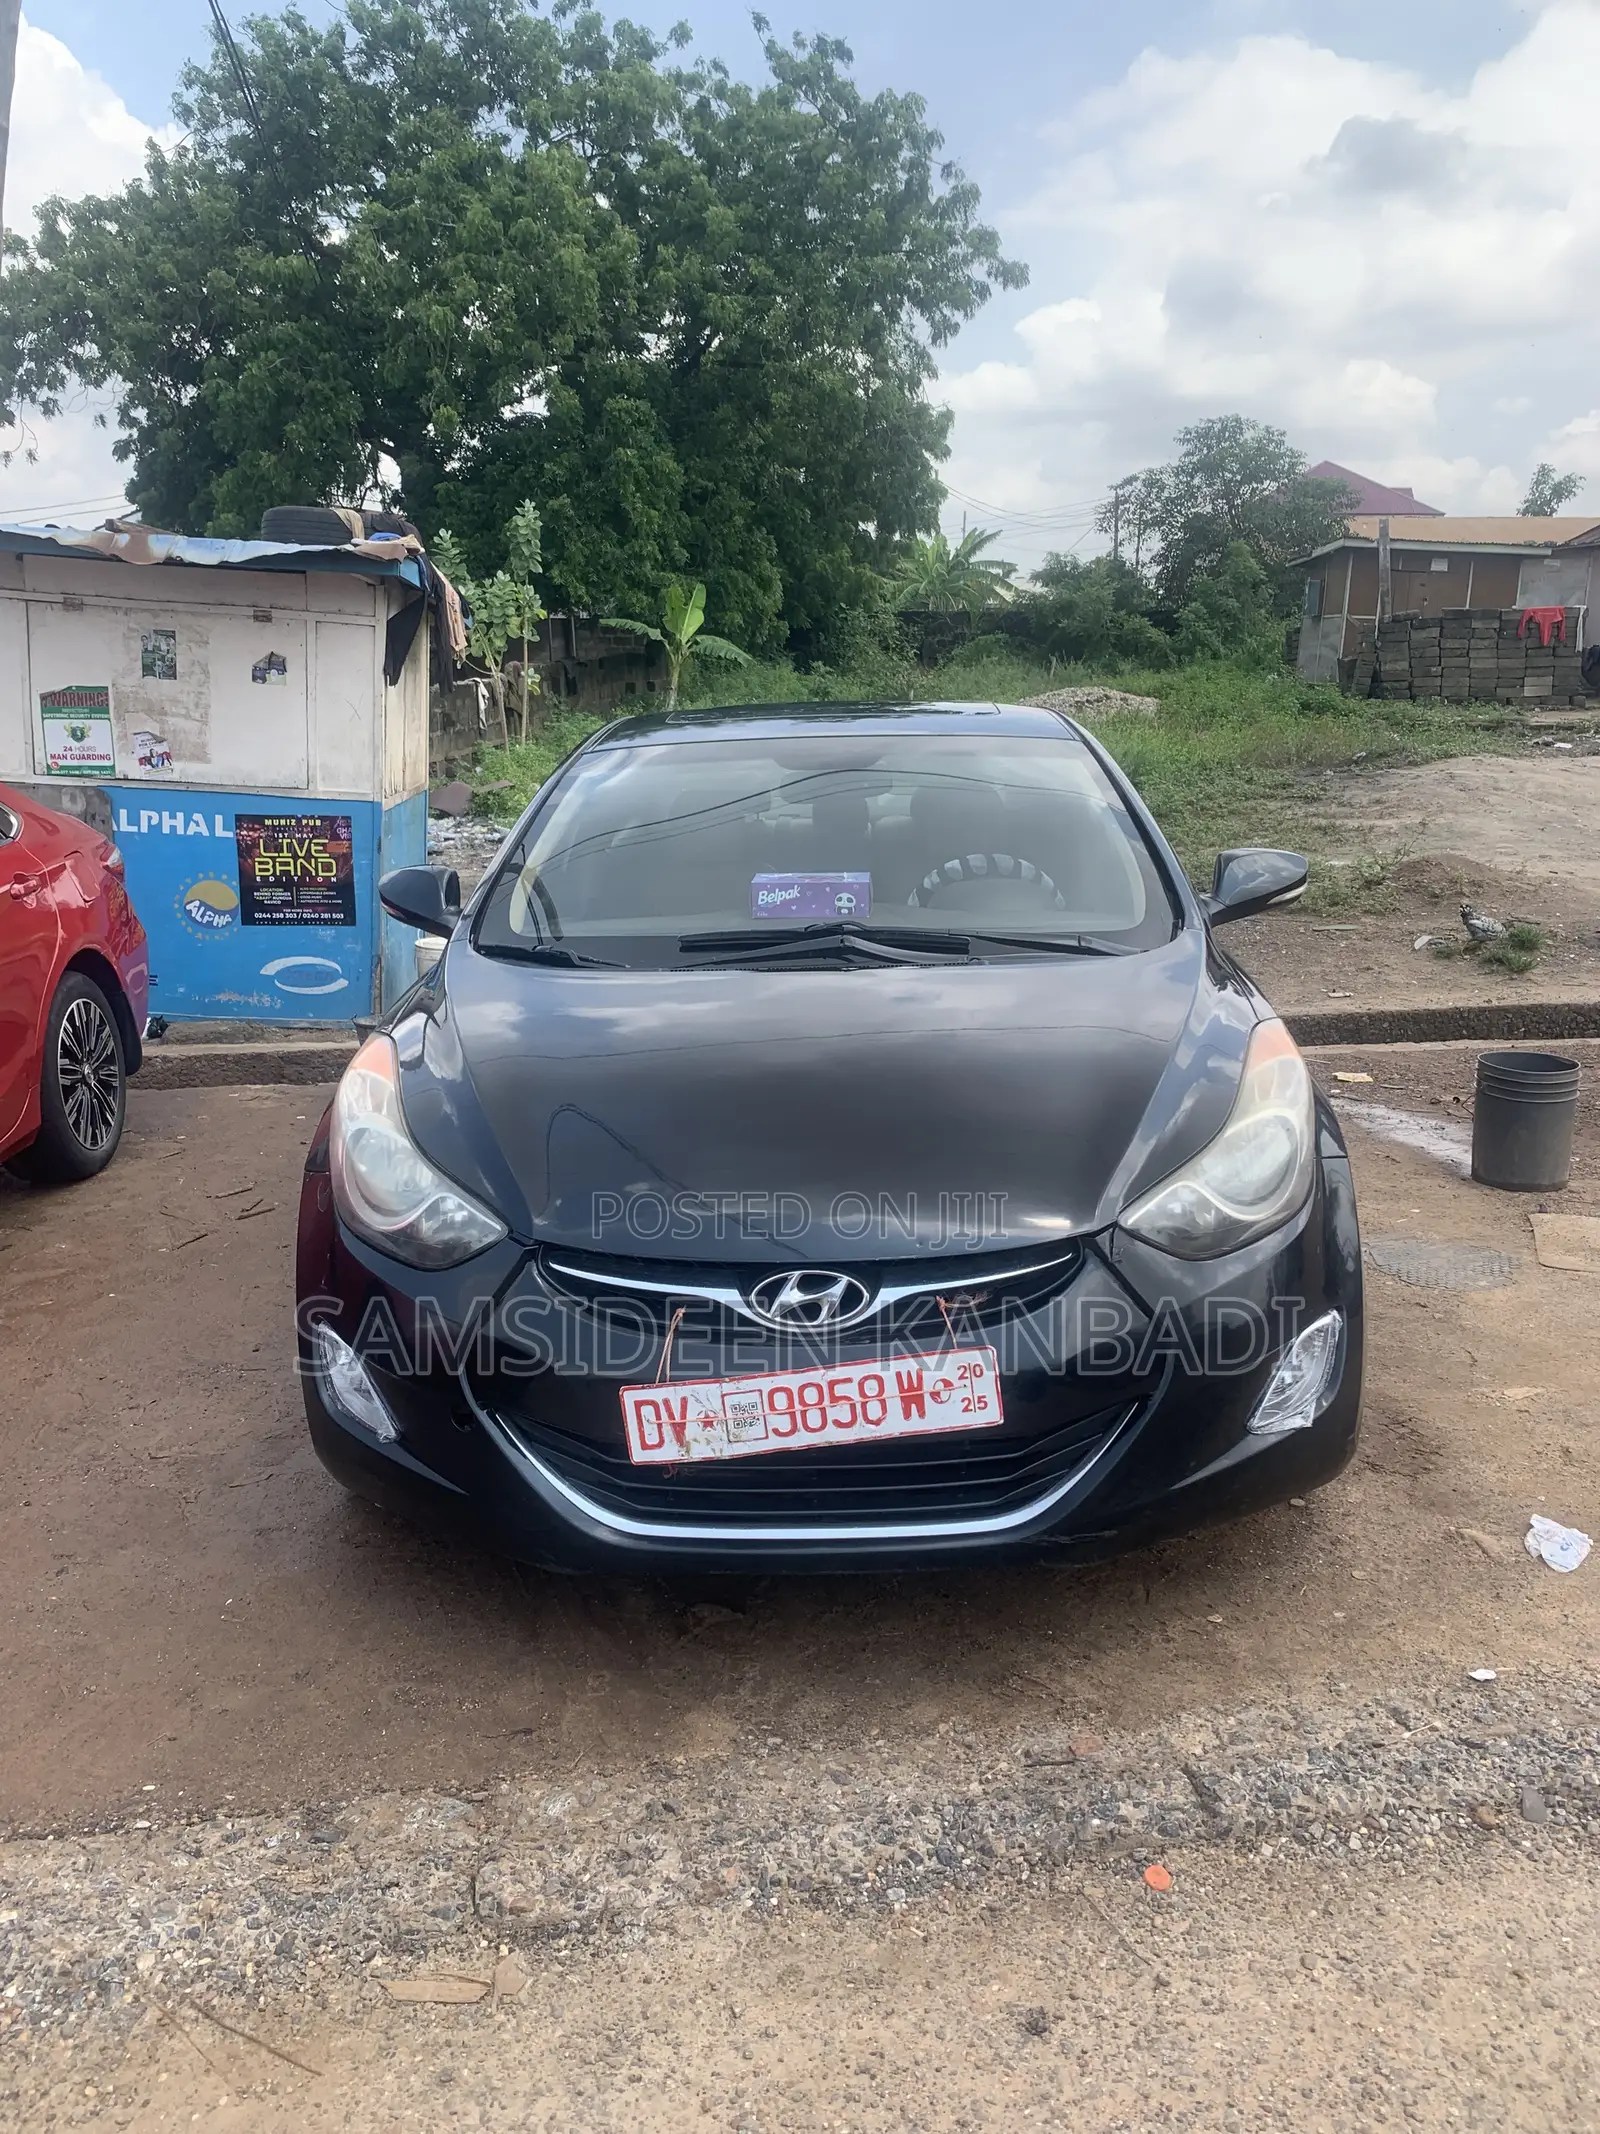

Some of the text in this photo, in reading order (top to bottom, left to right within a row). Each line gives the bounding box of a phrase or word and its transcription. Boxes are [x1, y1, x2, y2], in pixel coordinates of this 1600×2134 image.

[70, 753, 111, 761] GUARDING
[259, 839, 330, 857] LIVE
[254, 858, 337, 876] BAND
[757, 884, 801, 905] Belpak
[185, 899, 233, 928] ALPHA
[634, 1362, 985, 1451] DV 9858 W 20
[960, 1395, 989, 1414] 25
